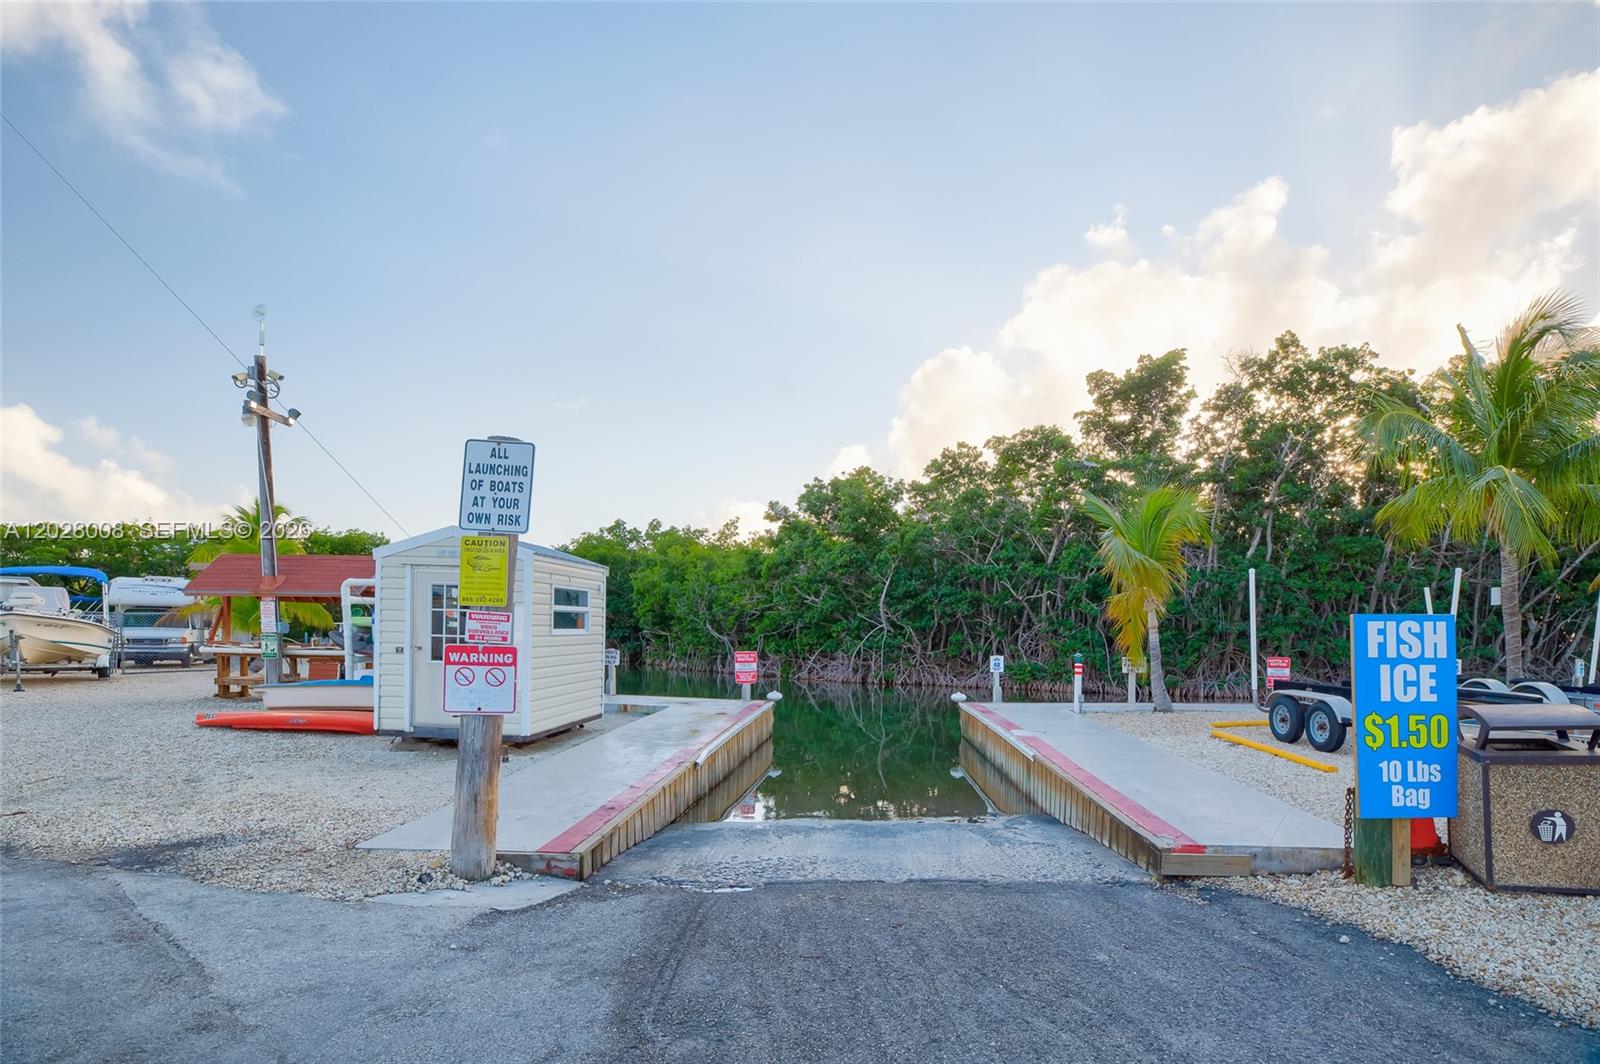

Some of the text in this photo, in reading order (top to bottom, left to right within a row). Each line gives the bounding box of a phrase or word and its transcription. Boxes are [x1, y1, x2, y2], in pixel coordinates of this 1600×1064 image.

[490, 447, 509, 459] ALL
[468, 462, 528, 477] LAUNCHING
[470, 479, 524, 493] OF BOATS
[472, 496, 520, 510] AT YOUR
[467, 512, 522, 526] OWN RISK
[464, 539, 506, 548] CAUTION
[471, 613, 508, 621] WARNING
[1367, 620, 1448, 659] FISH
[449, 652, 513, 664] WARNING
[1380, 663, 1438, 703] ICE
[1363, 712, 1449, 751] $1.50
[1379, 760, 1441, 783] 10 Lbs
[1391, 786, 1430, 810] Bag
